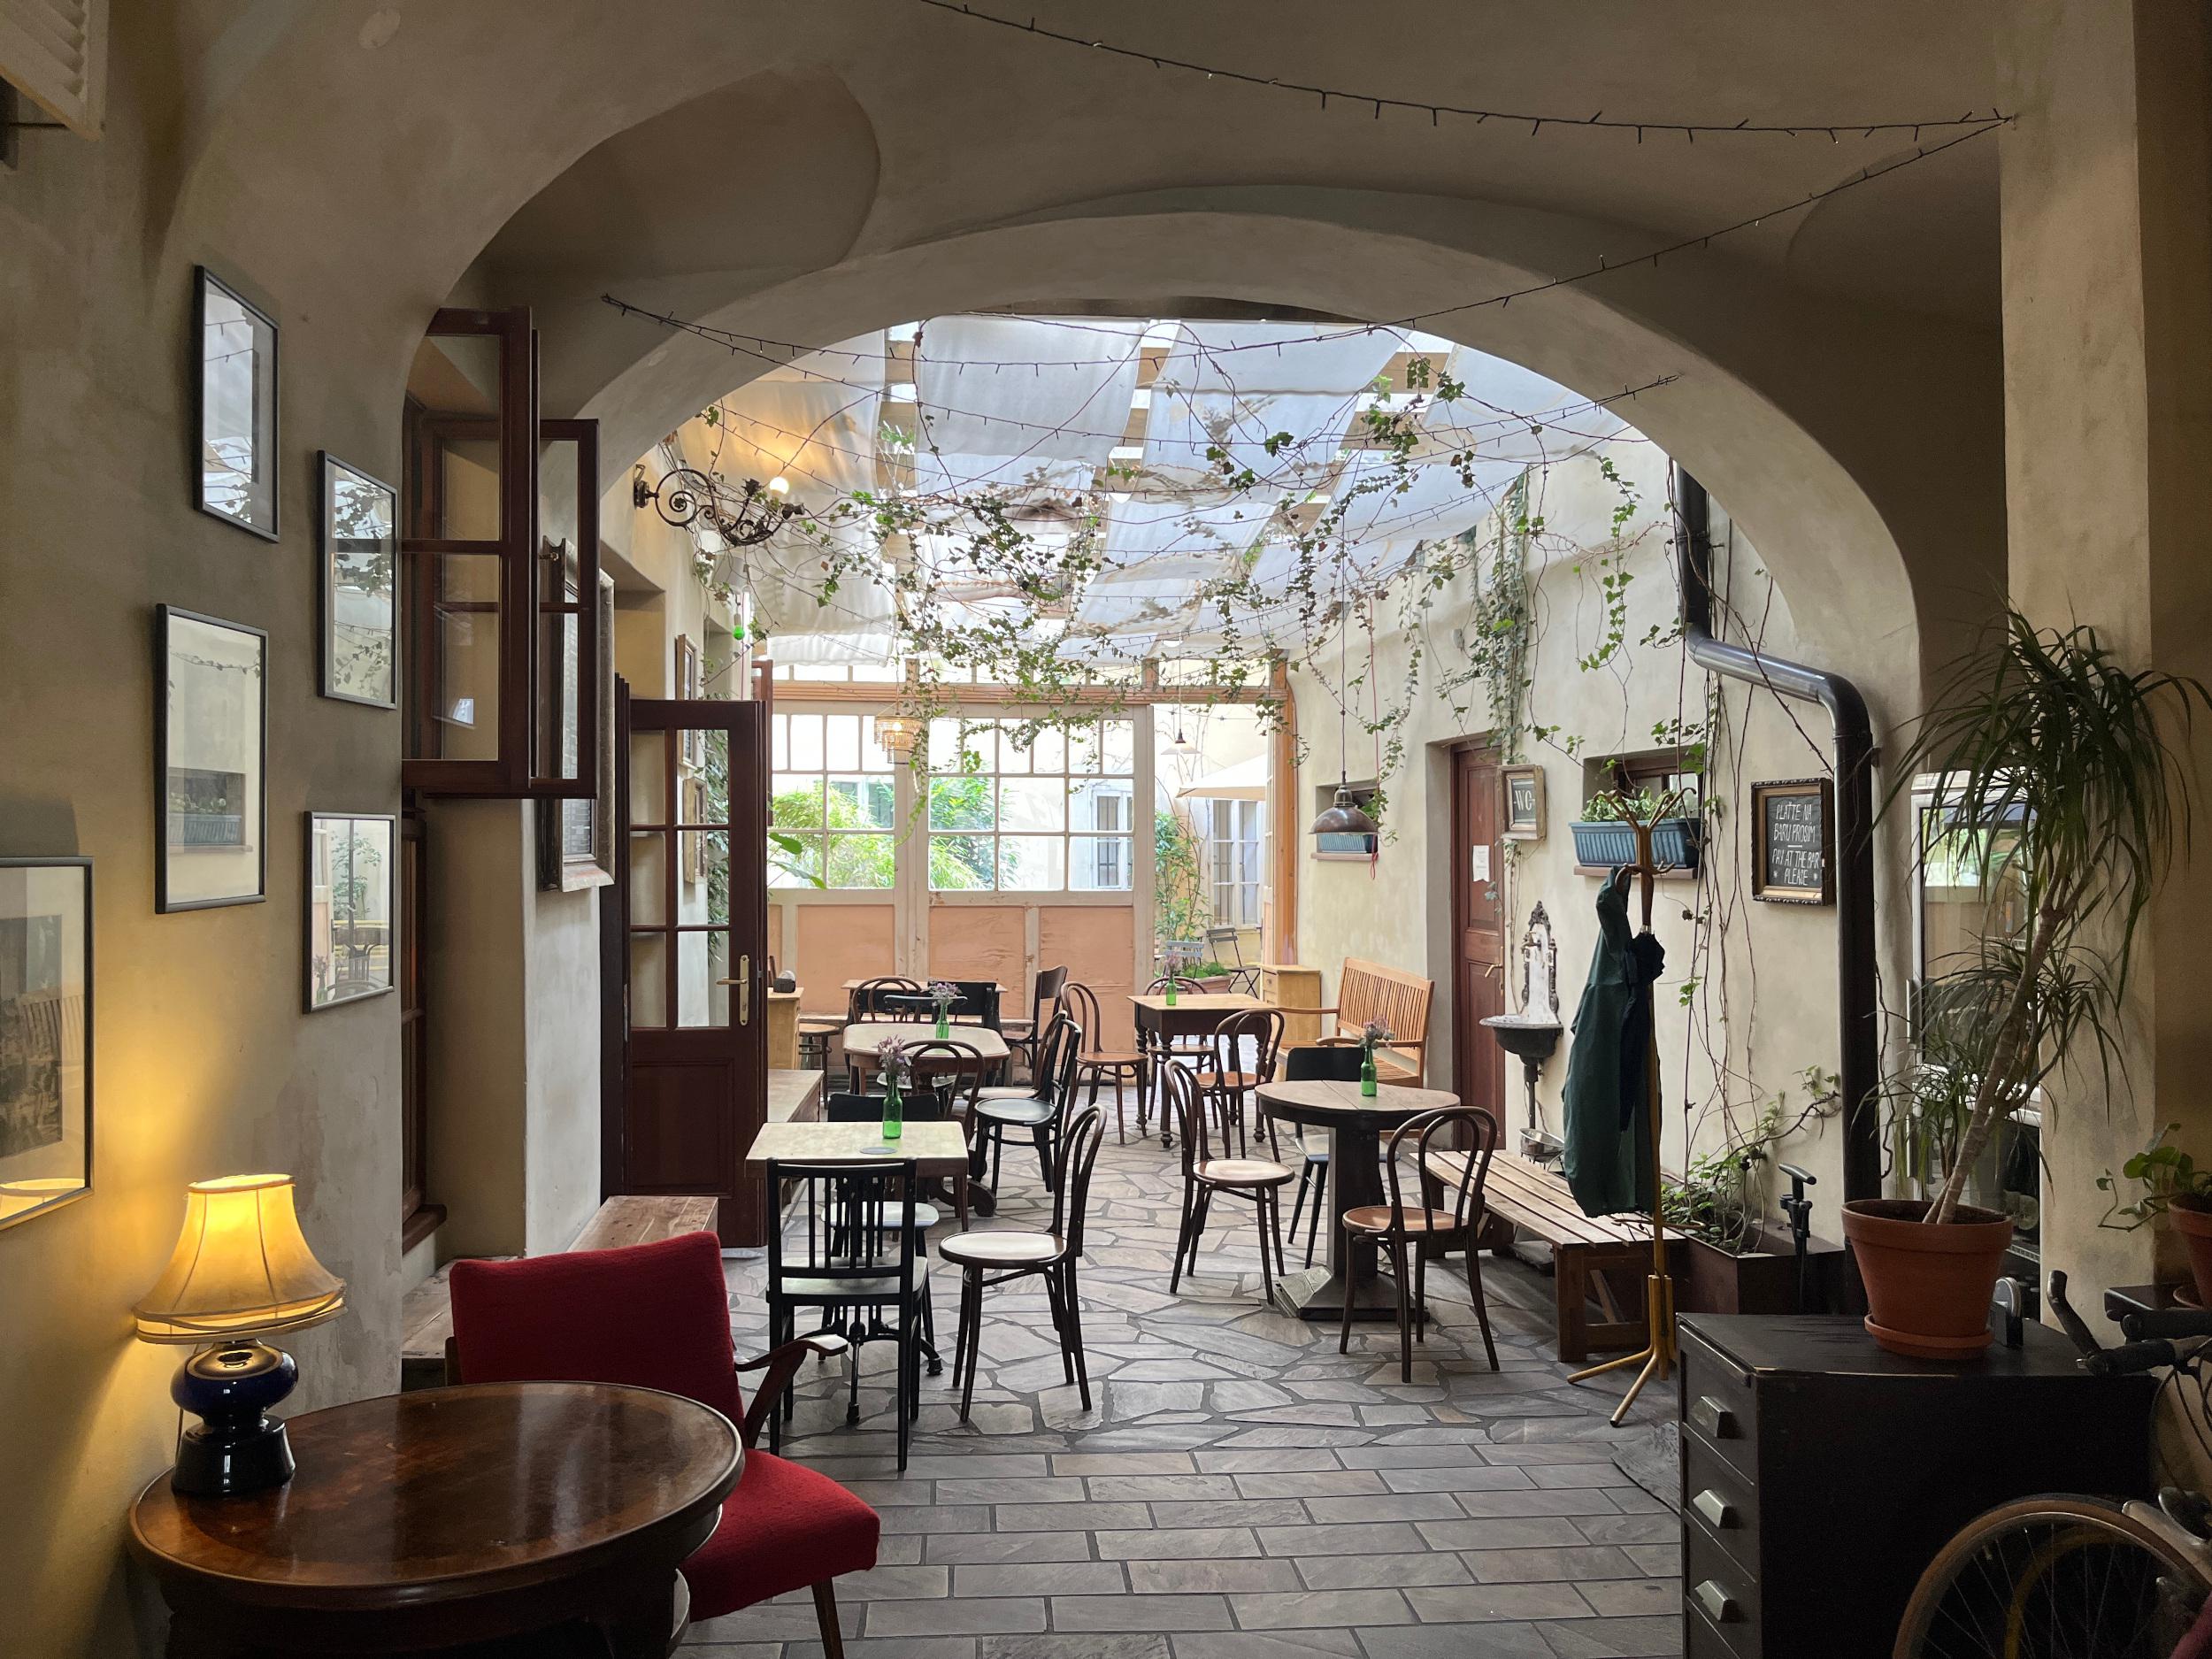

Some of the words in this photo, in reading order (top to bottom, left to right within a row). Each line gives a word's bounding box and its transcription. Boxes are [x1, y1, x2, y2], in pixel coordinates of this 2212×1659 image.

[1803, 803, 1812, 821] NA
[1773, 823, 1792, 842] BARU
[1772, 849, 1785, 864] PAY
[1785, 850, 1793, 866] AT
[1795, 850, 1807, 868] THE
[1807, 851, 1820, 869] BAR
[1784, 868, 1809, 886] PLEASE
